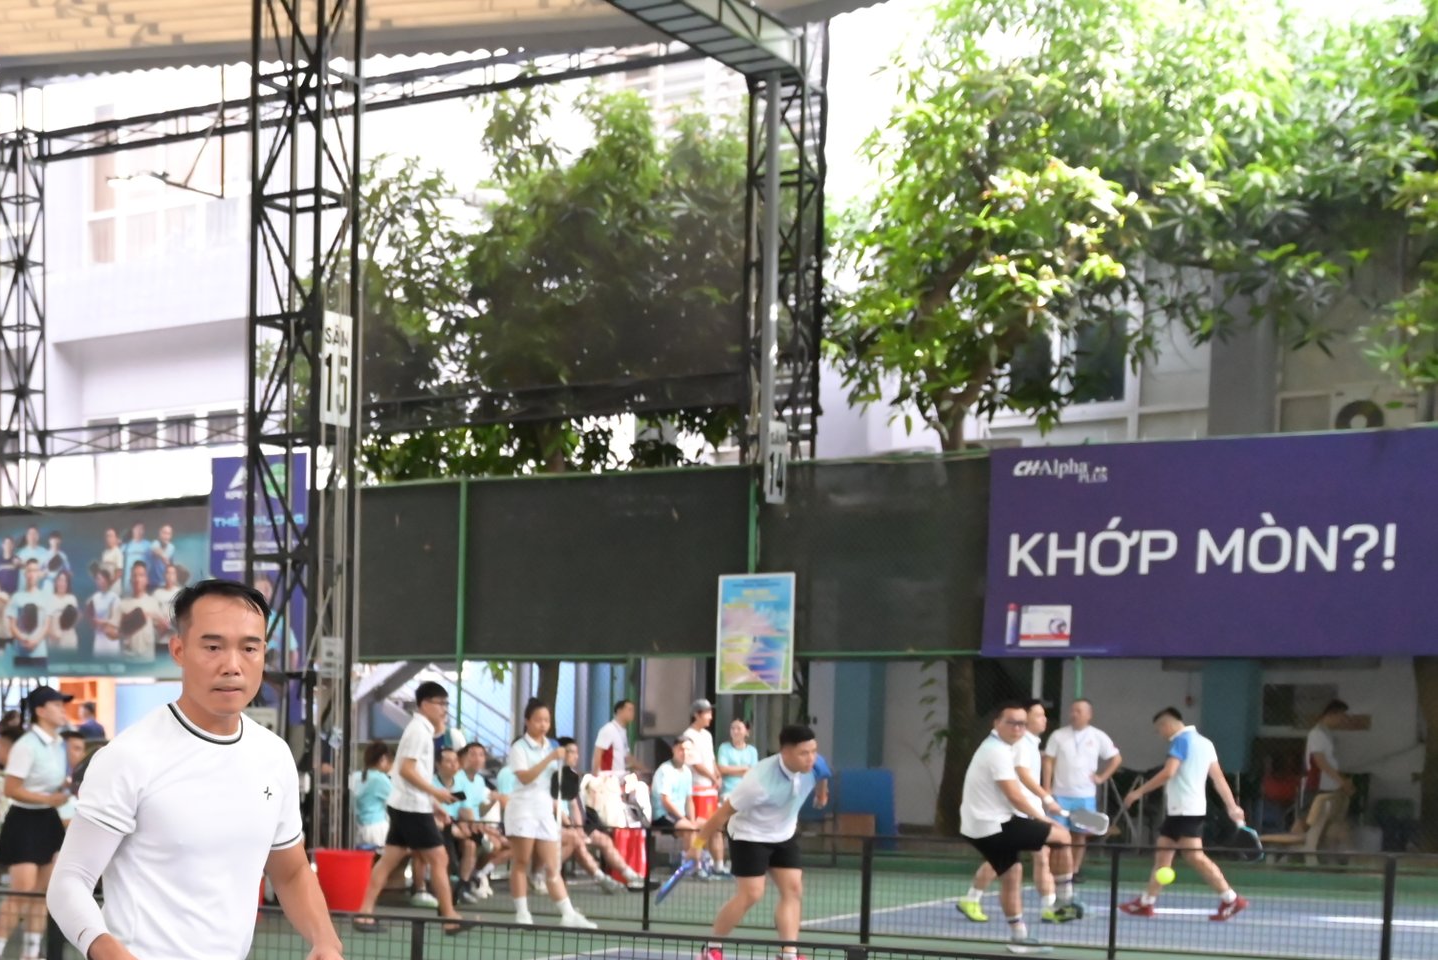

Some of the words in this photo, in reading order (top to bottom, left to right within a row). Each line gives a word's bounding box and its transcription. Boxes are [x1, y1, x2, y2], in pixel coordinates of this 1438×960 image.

[325, 353, 348, 415] 15
[770, 452, 783, 496] 14
[1008, 516, 1178, 577] KHỚP
[1196, 512, 1397, 574] MÒN?!
